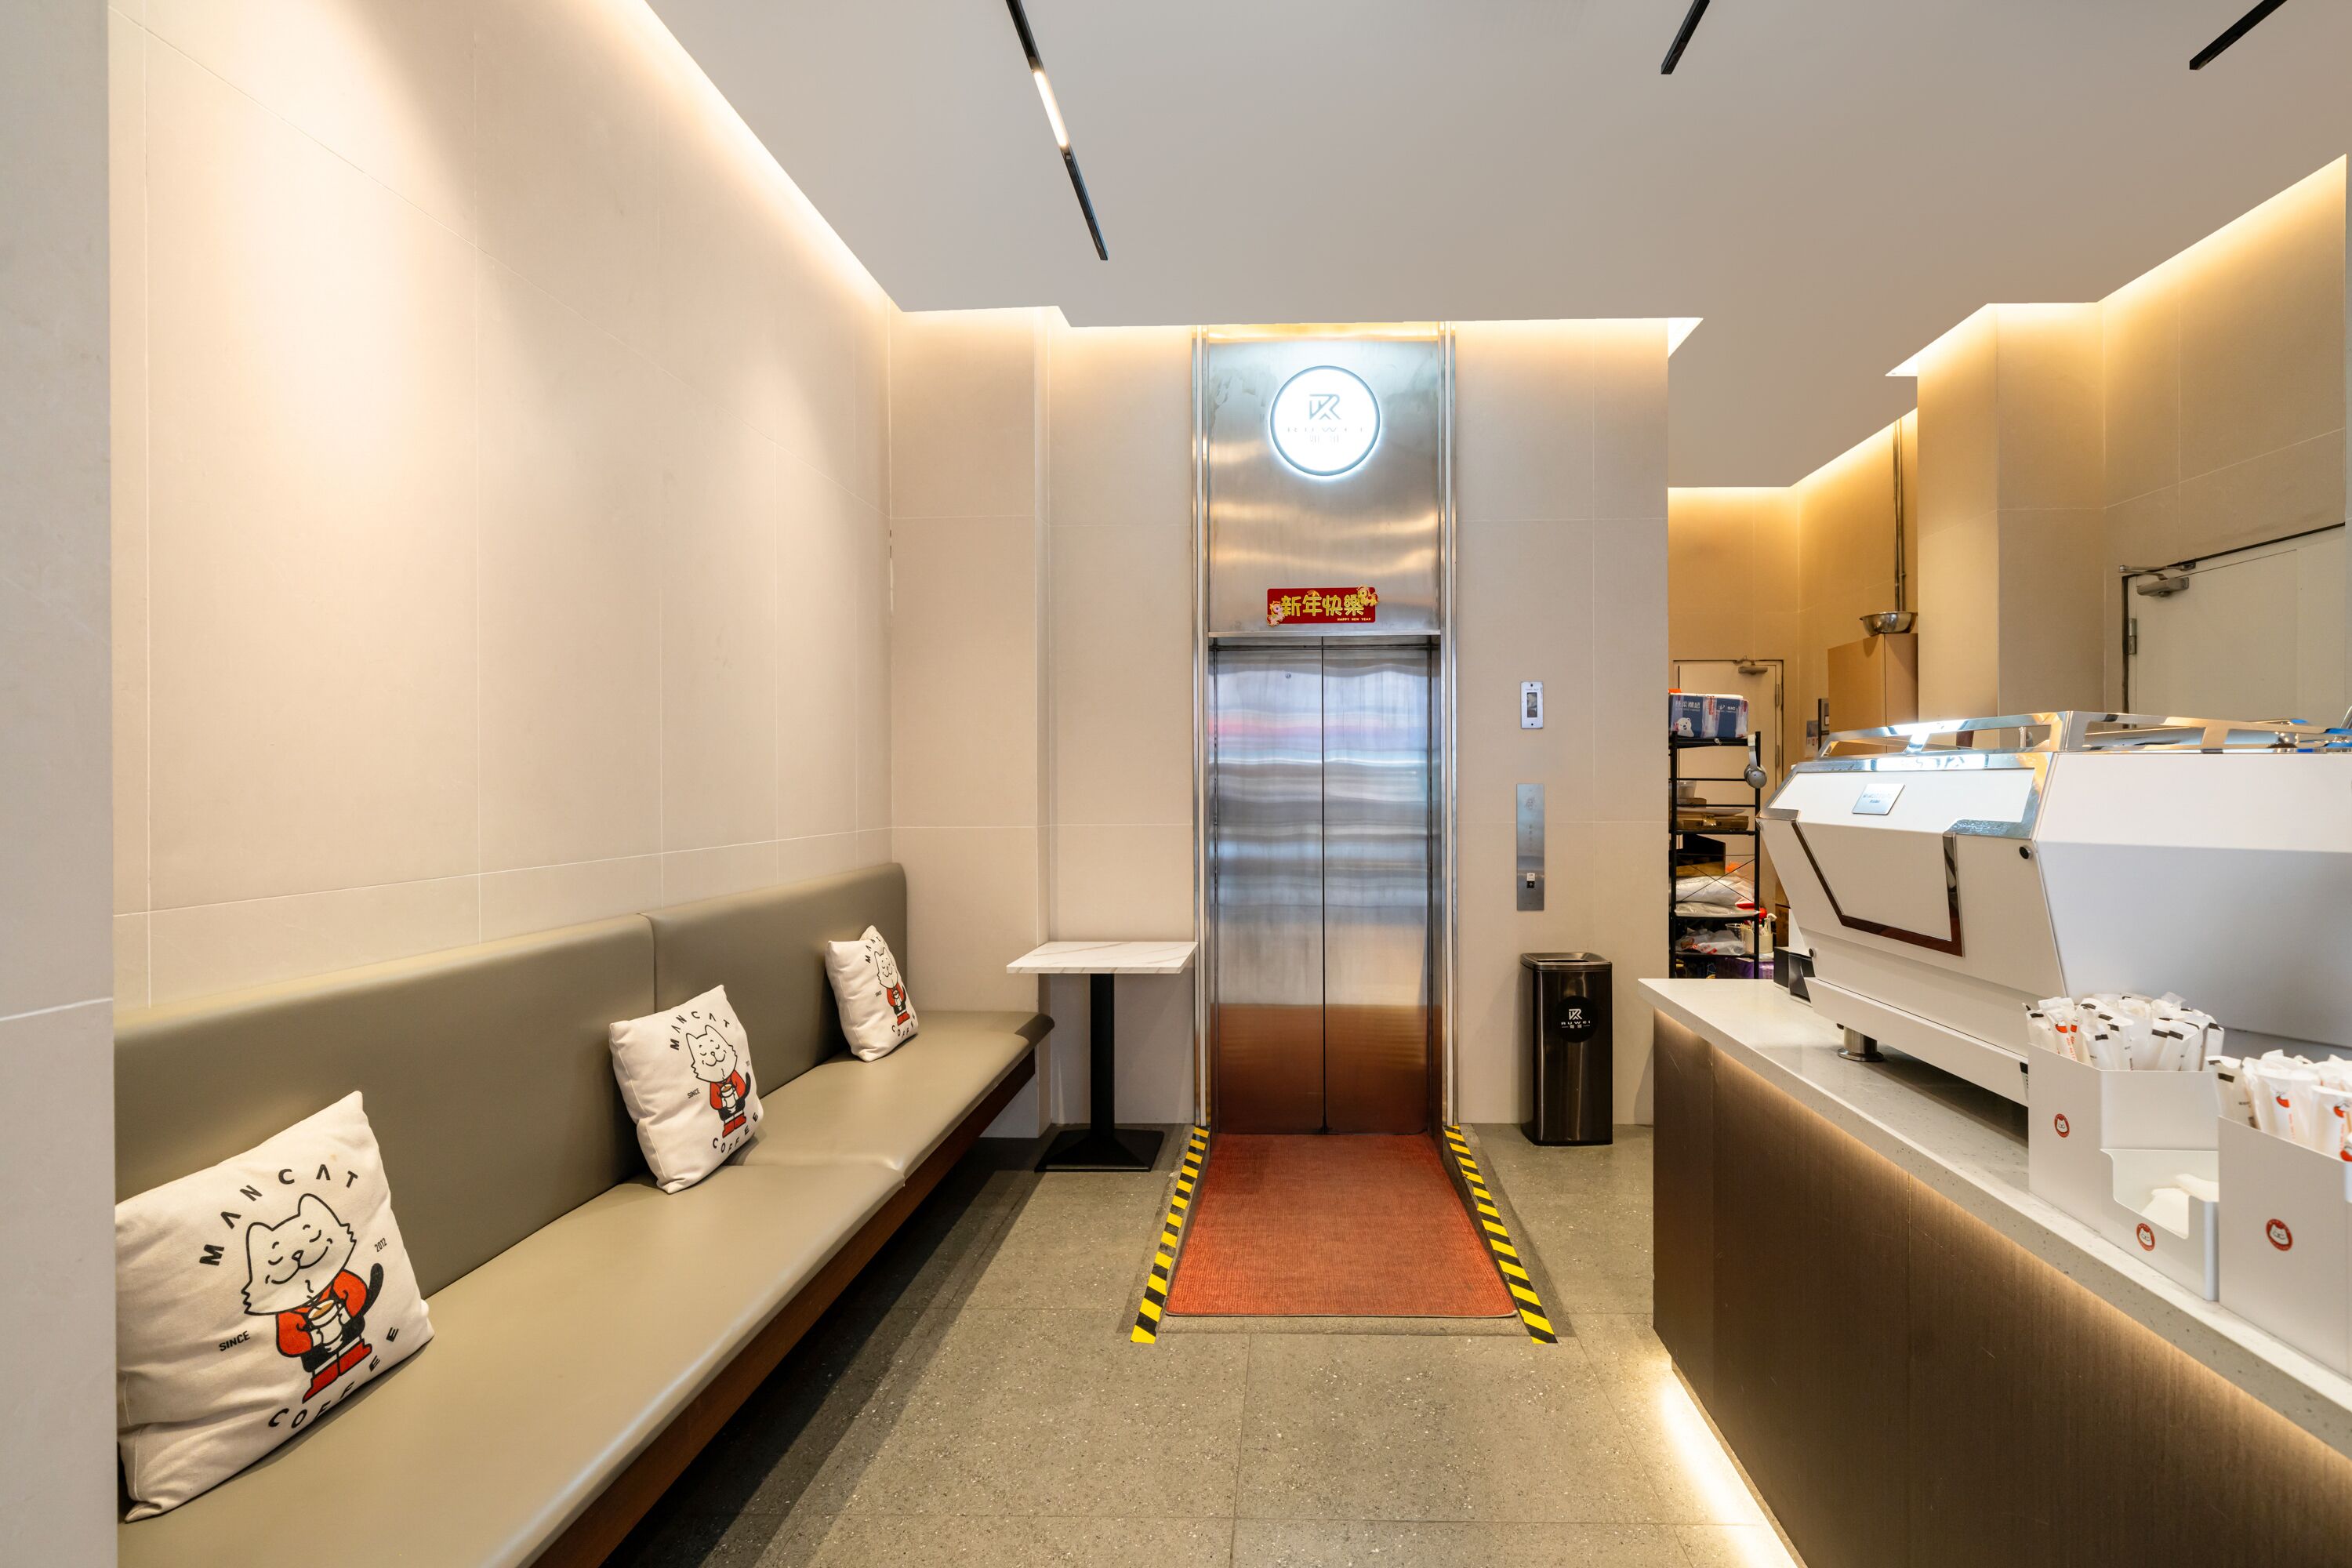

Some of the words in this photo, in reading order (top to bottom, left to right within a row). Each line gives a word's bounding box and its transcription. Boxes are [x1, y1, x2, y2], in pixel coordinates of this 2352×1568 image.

[1281, 594, 1364, 617] 新年快樂
[670, 1011, 730, 1051] MANCAT
[687, 1087, 700, 1099] SINCE
[713, 1112, 759, 1154] COFFEE
[199, 1163, 358, 1267] MANCAT
[373, 1237, 388, 1253] 2012
[218, 1330, 251, 1352] SINCE
[267, 1327, 400, 1429] COFFEE
